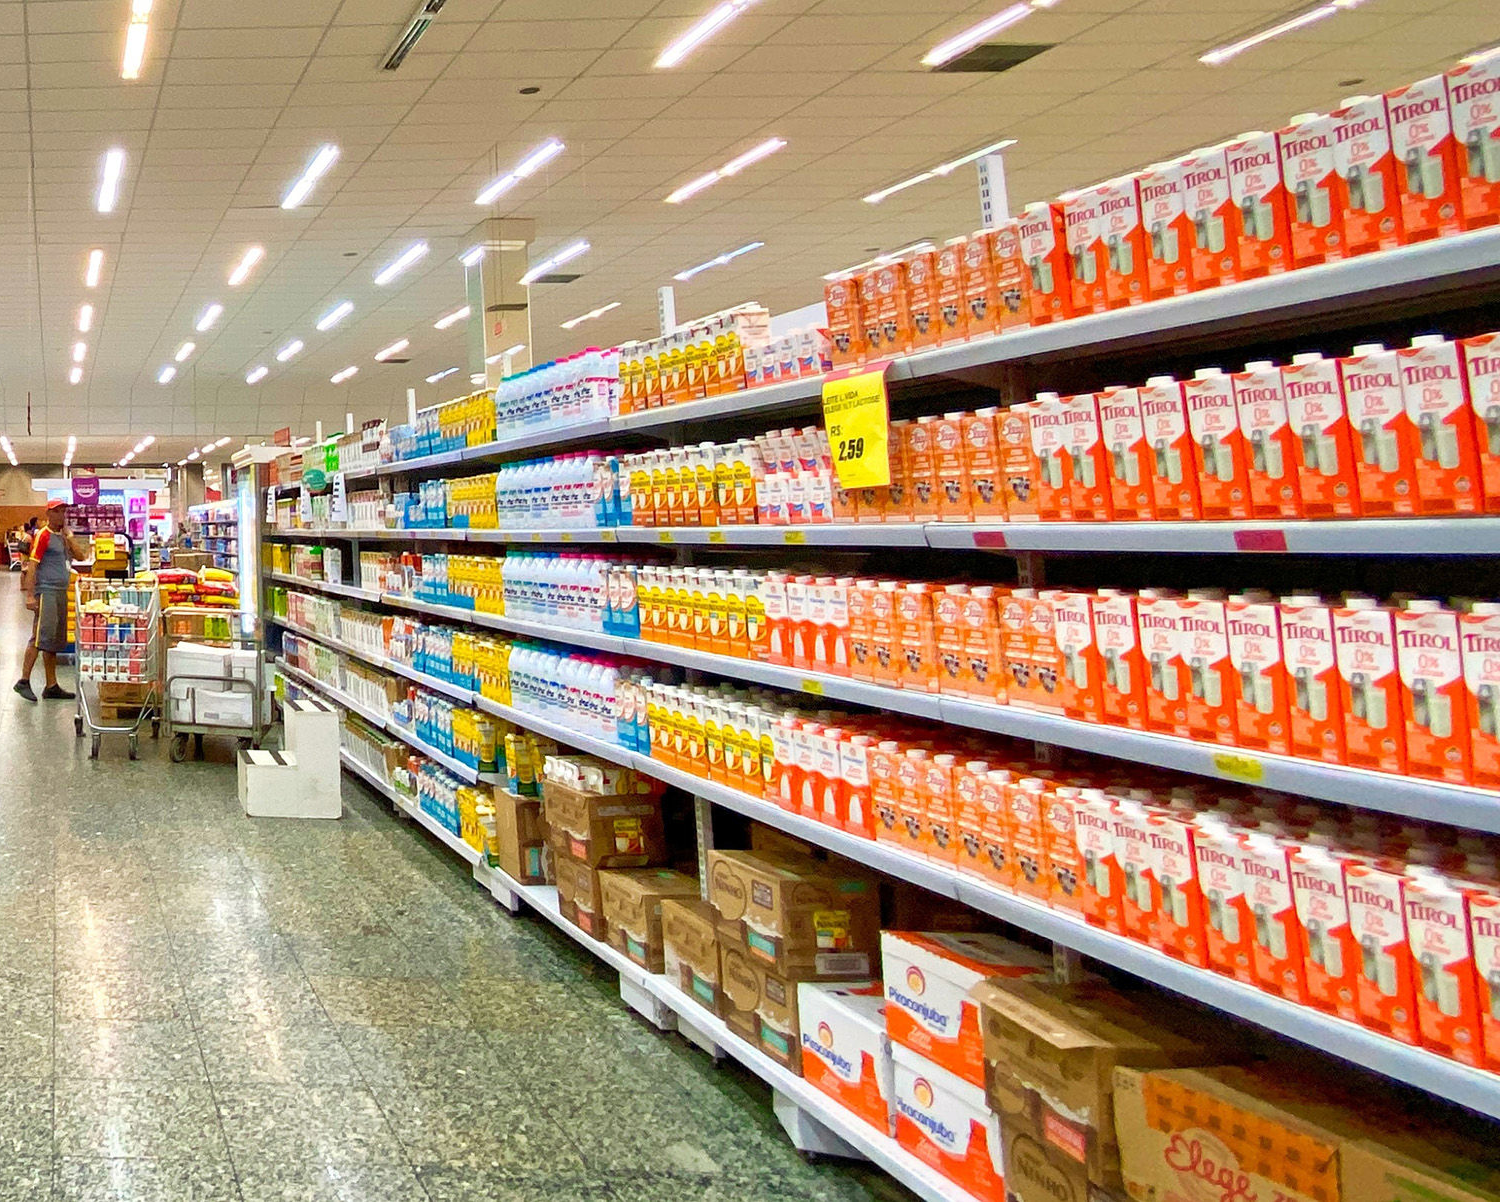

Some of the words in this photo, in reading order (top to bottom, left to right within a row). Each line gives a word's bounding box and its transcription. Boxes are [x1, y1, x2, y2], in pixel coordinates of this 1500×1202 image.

[1390, 97, 1446, 124] TIROL
[1333, 116, 1384, 143] TIROL
[1282, 134, 1332, 159] TIROL
[1229, 151, 1275, 176] TIROL
[1183, 168, 1225, 190] TIROL
[1141, 181, 1180, 203] TIROL
[1100, 196, 1134, 216] TIROL
[1066, 208, 1098, 227] TIROL
[1020, 221, 1051, 239] TIROL
[1403, 364, 1458, 385] TIROL
[1468, 356, 1500, 377] TIR
[1286, 380, 1337, 399] TIROL
[1345, 372, 1398, 392] TIROL
[1143, 398, 1181, 416] TIROL
[1189, 393, 1233, 411] TIROL
[1237, 388, 1282, 405] TIROL
[1030, 413, 1062, 429] TIROL
[1062, 408, 1095, 425] TIROL
[1101, 403, 1139, 421] TIROL
[1056, 607, 1088, 625] TIROL
[1095, 610, 1132, 628] TIROL
[1139, 613, 1179, 631] TIROL
[1179, 616, 1224, 635] TIROL
[1228, 619, 1275, 639] TIROL
[1283, 622, 1330, 643] TIROL
[1337, 626, 1390, 647] TIROL
[1398, 629, 1456, 651] TIROL
[1076, 810, 1110, 831] TIROL
[1112, 822, 1148, 843] TIROL
[1150, 833, 1188, 857] TIROL
[1197, 846, 1238, 869] TIROL
[1241, 858, 1285, 883] TIROL
[1292, 872, 1343, 897] TIROL
[1350, 885, 1399, 913] TIROL
[1408, 901, 1462, 930] TIROL
[897, 1096, 955, 1142] iracanjuba
